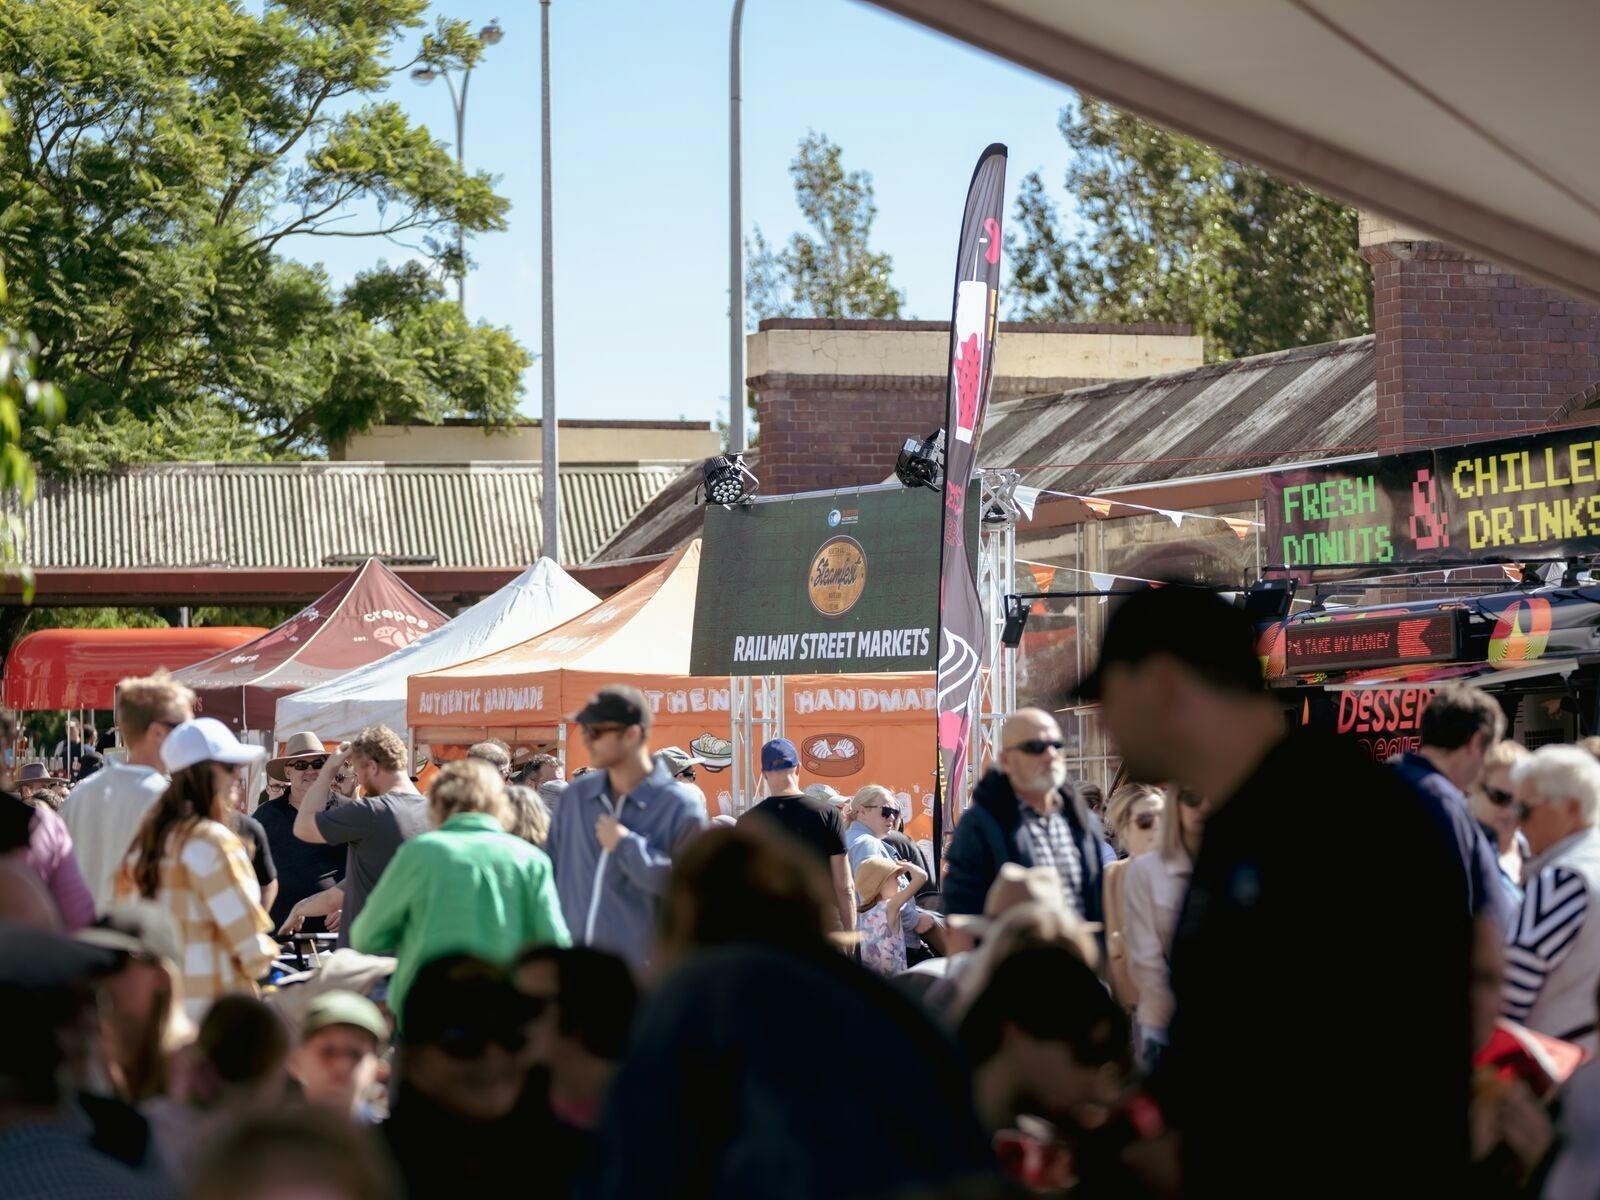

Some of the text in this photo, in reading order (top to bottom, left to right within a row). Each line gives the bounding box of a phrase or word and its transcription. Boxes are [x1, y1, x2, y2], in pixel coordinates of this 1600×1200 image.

[1283, 475, 1377, 524] FRESH
[1282, 525, 1394, 566] DONUTS
[733, 628, 930, 662] RAILWAY STREET MARKETS
[1306, 636, 1332, 655] TAKE
[1334, 635, 1350, 653] MY
[1351, 631, 1391, 651] MONEY
[419, 685, 544, 716] AUTHENTIC HANDMADE
[794, 687, 937, 715] HANDMAD
